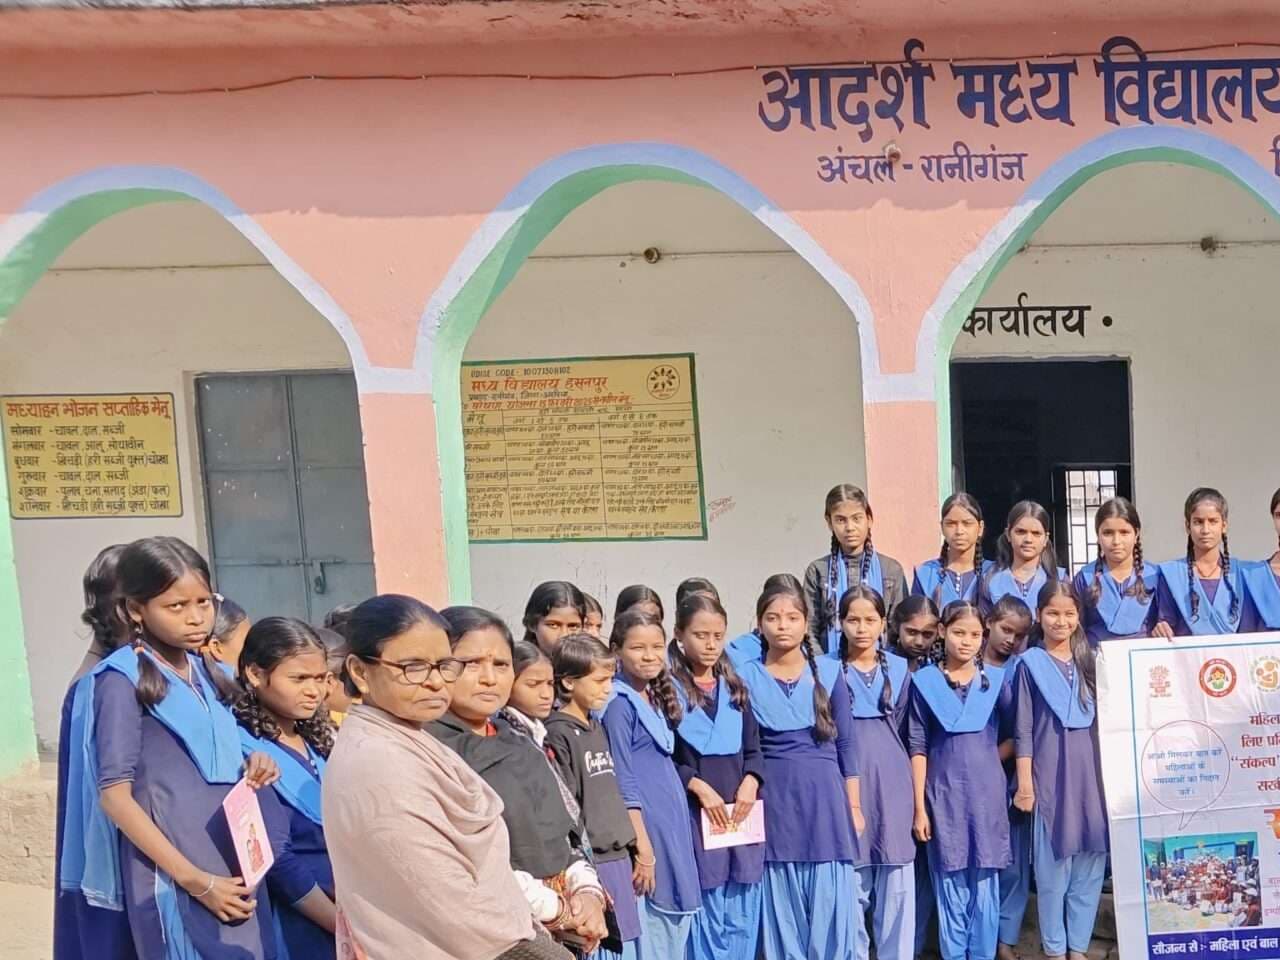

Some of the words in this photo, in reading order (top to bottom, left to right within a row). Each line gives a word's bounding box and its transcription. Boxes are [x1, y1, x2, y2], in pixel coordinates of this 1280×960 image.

[758, 39, 935, 143] आदर्श
[949, 59, 1078, 128] मध्य
[962, 292, 1091, 338] कार्यालय
[564, 376, 609, 394] हसनपुर
[63, 398, 99, 418] भोजन
[10, 423, 42, 436] सोमवार
[1241, 733, 1264, 748] लिए
[1152, 940, 1187, 955] सौजन्य
[1209, 937, 1241, 952] महिला
[1242, 936, 1258, 951] एवं
[1259, 936, 1279, 949] बाल
